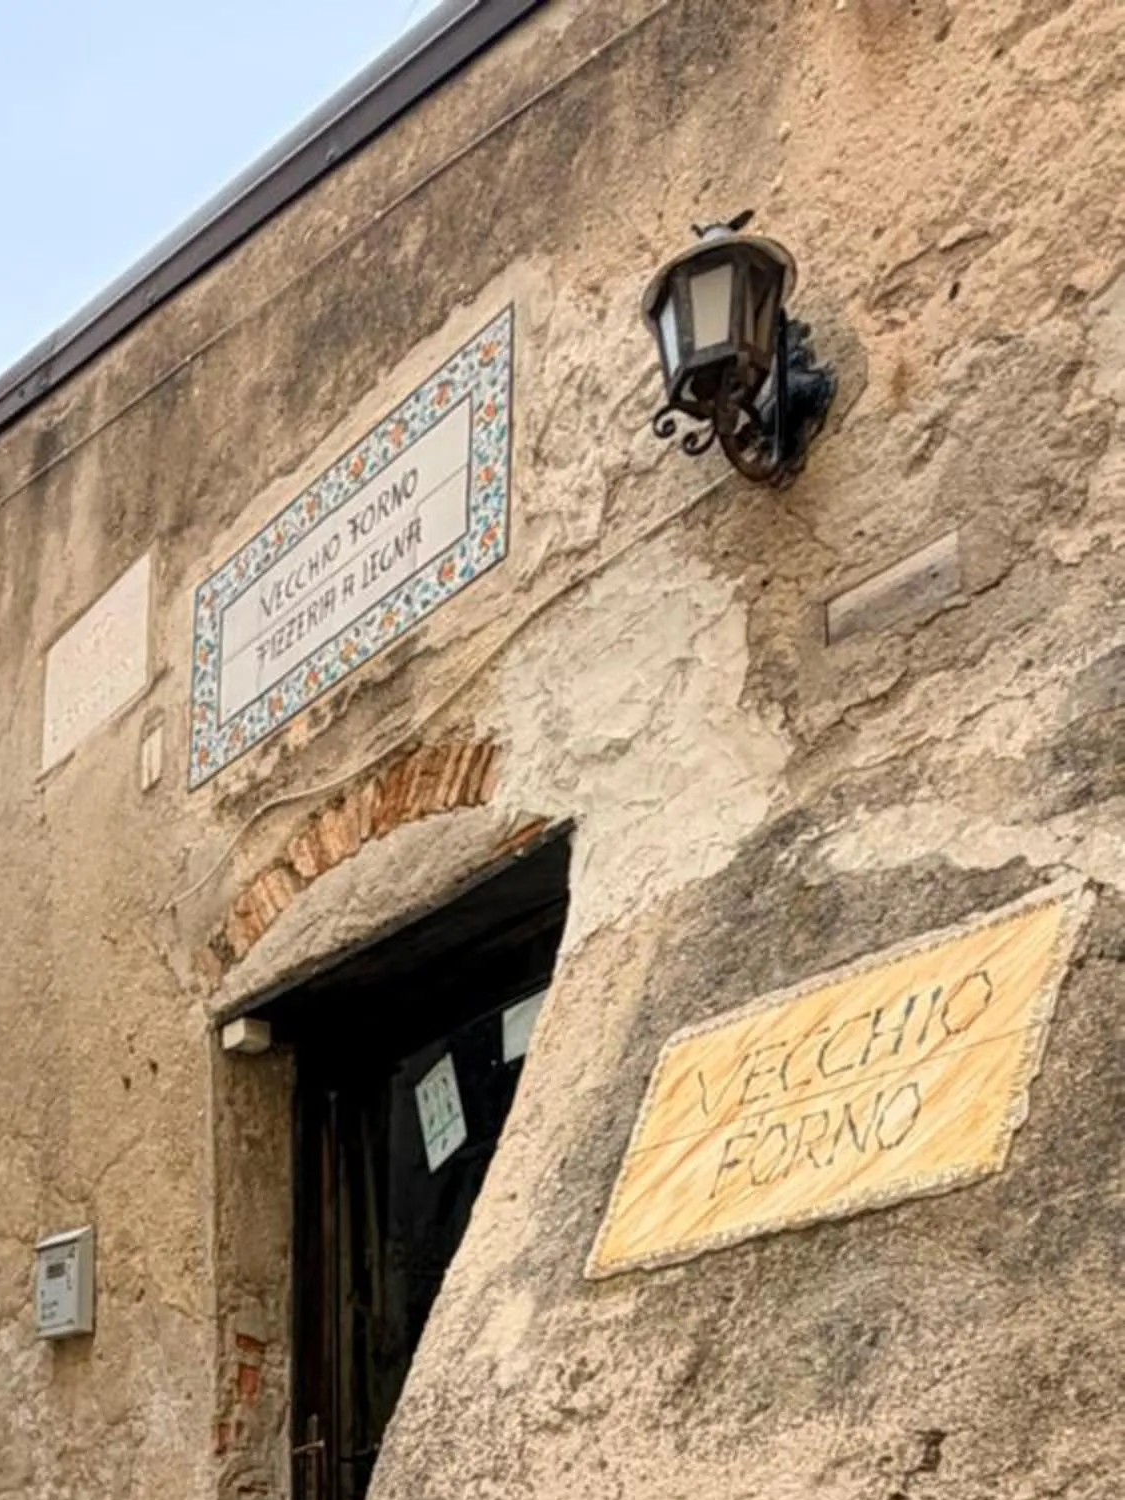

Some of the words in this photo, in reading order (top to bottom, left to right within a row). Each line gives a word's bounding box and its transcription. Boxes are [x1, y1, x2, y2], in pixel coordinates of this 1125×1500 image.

[255, 586, 335, 674] PIZZERIA
[342, 573, 355, 602] A
[361, 517, 422, 589] LEGNA
[259, 533, 340, 616] VECCHIO
[347, 468, 418, 545] FORNO
[697, 970, 993, 1116] VECCHIO
[709, 1081, 922, 1199] FORNO
